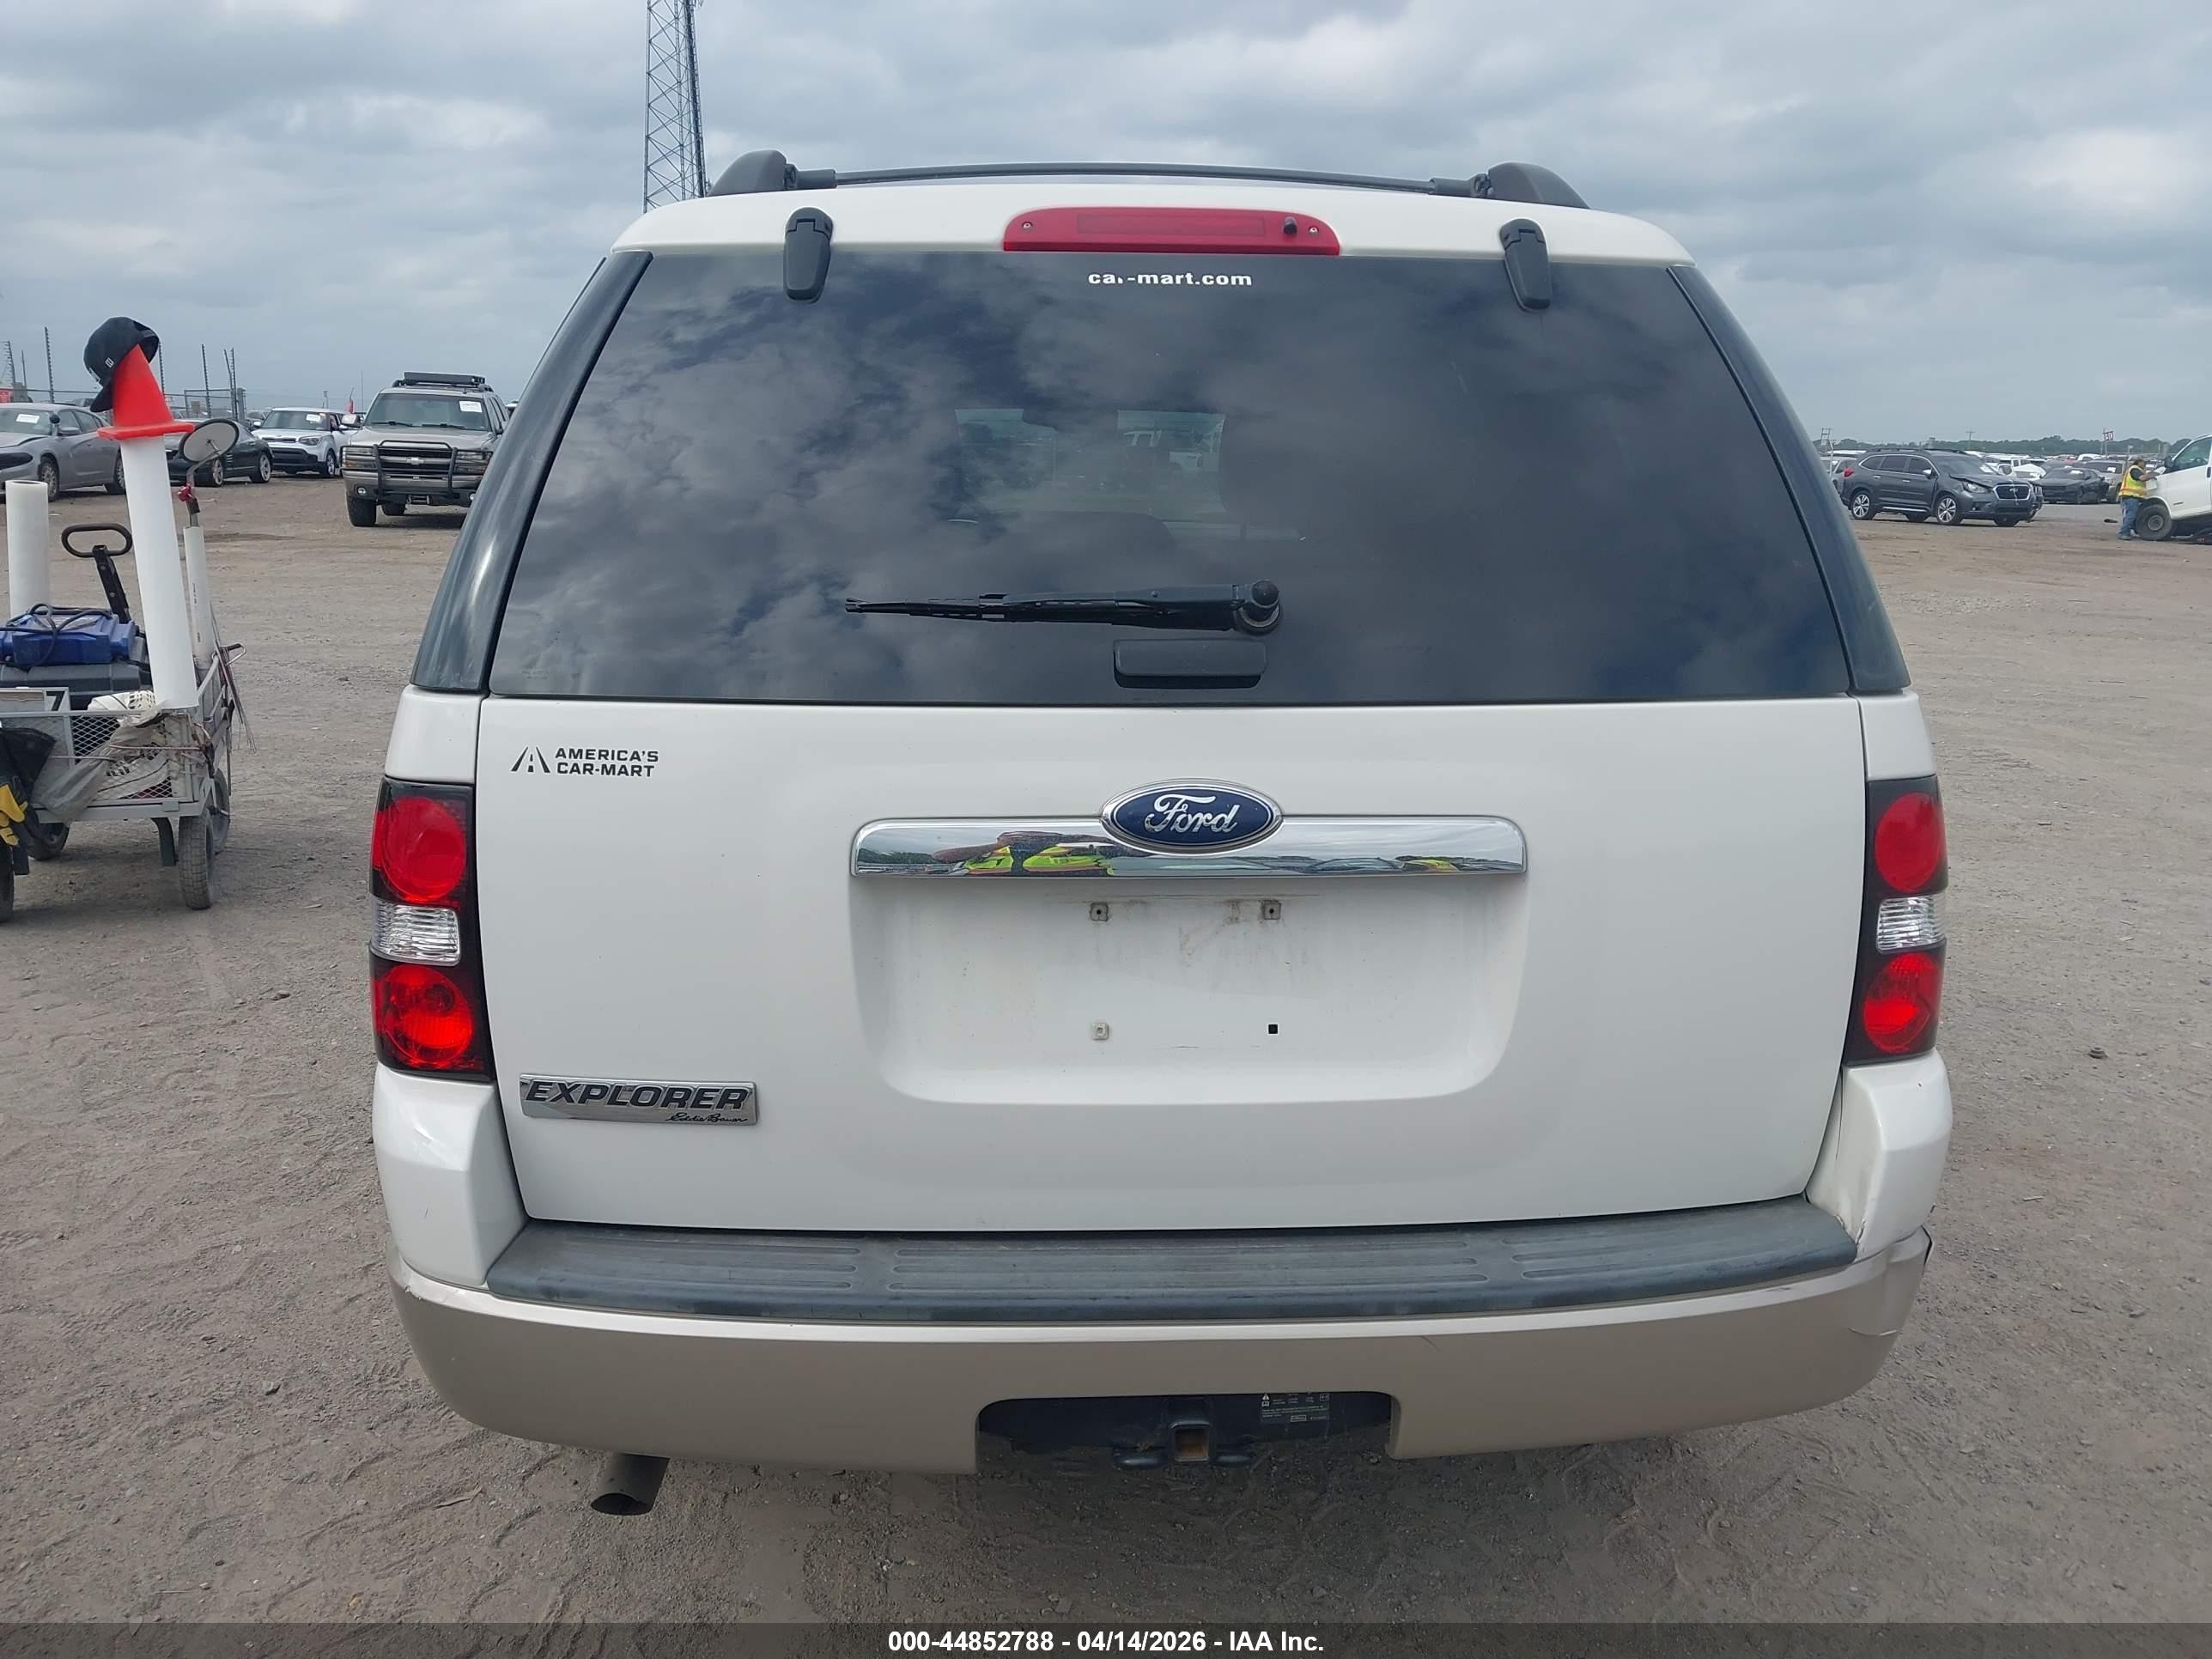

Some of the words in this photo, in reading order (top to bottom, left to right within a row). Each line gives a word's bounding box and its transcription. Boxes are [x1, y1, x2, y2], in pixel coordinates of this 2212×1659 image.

[46, 690, 65, 711] 7
[555, 747, 659, 763] AMERICA'S
[556, 762, 654, 777] CAR-MART
[1144, 793, 1241, 833] Ford
[525, 1080, 750, 1110] EXPLORER
